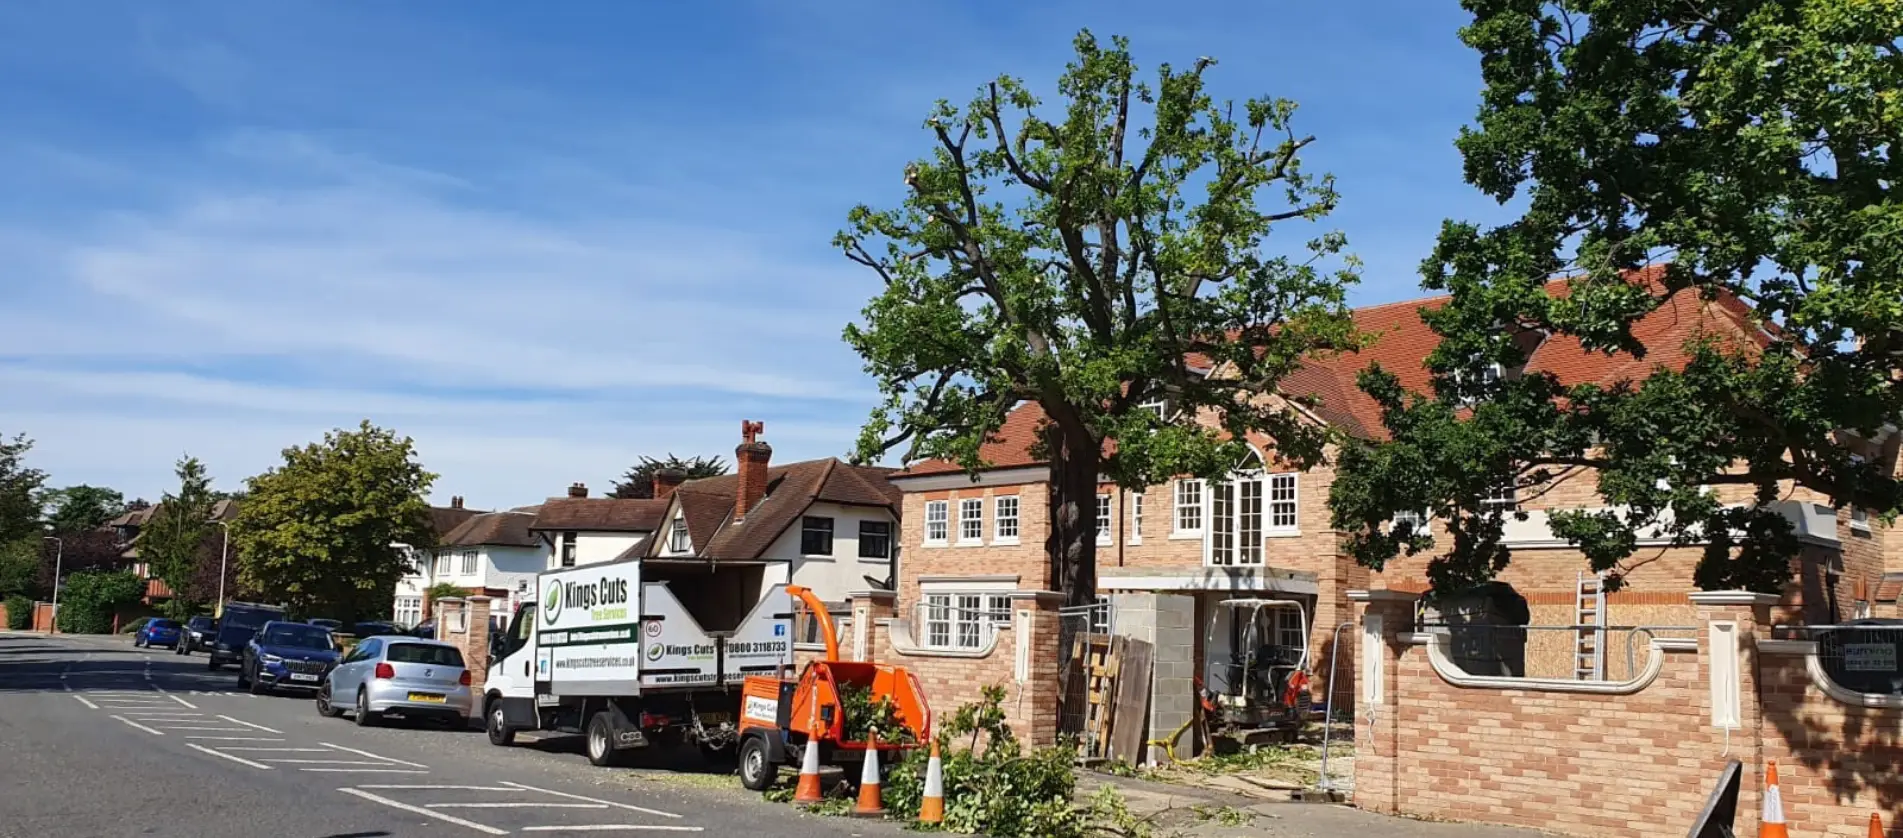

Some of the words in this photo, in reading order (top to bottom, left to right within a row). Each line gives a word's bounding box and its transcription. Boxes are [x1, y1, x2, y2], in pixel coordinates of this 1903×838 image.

[565, 581, 597, 611] Kings
[600, 576, 627, 605] Cuts
[666, 644, 692, 657] Kings
[694, 644, 715, 655] Cuts
[728, 642, 751, 653] 0800
[753, 641, 786, 652] 3118733
